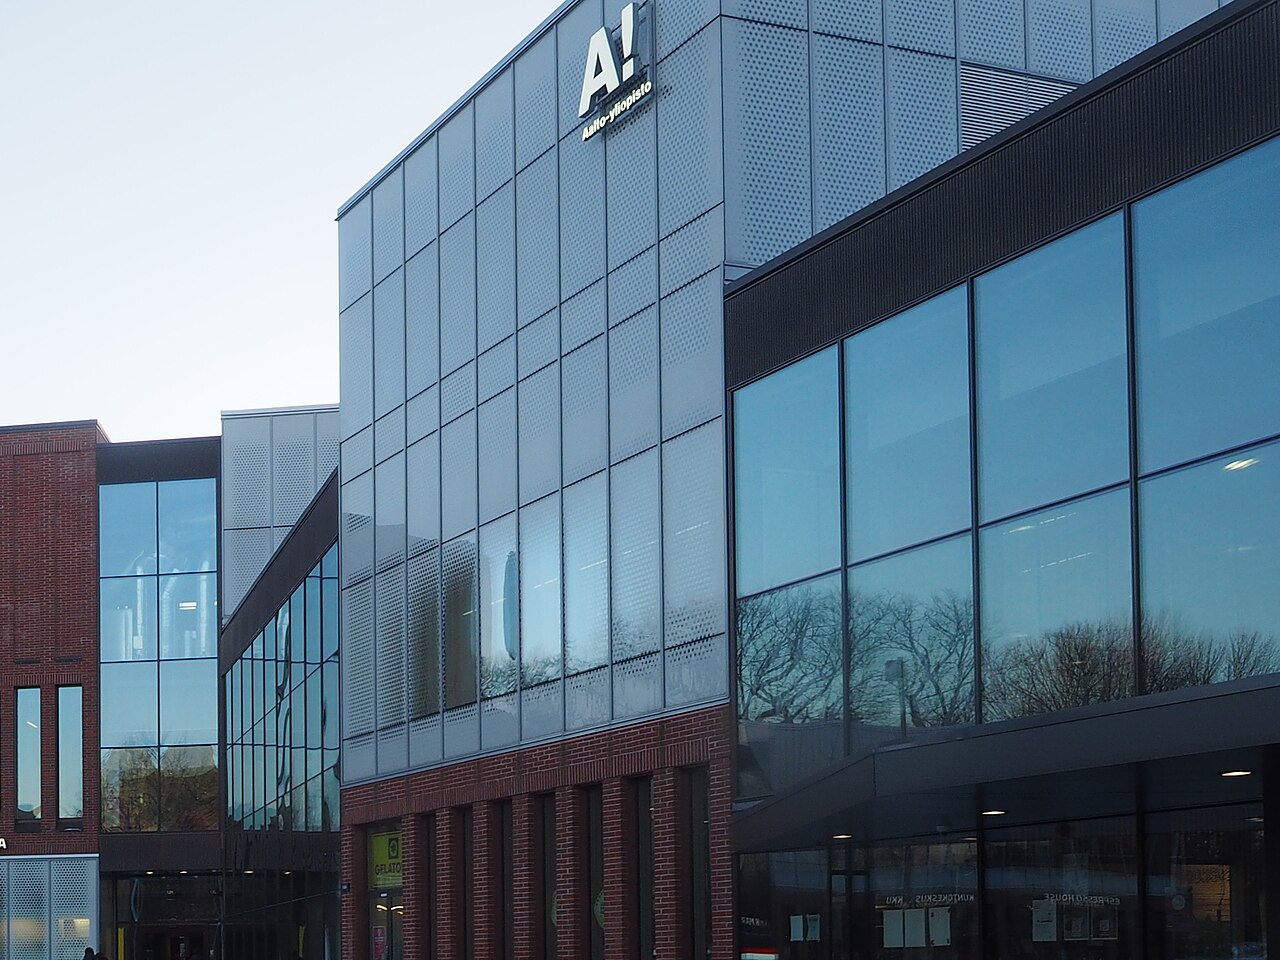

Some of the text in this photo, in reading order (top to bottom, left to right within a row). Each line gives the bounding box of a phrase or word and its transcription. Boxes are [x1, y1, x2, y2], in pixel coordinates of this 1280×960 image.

[578, 2, 635, 118] A!
[582, 81, 652, 142] Aalto-yliopisto
[375, 862, 401, 875] GELATO
